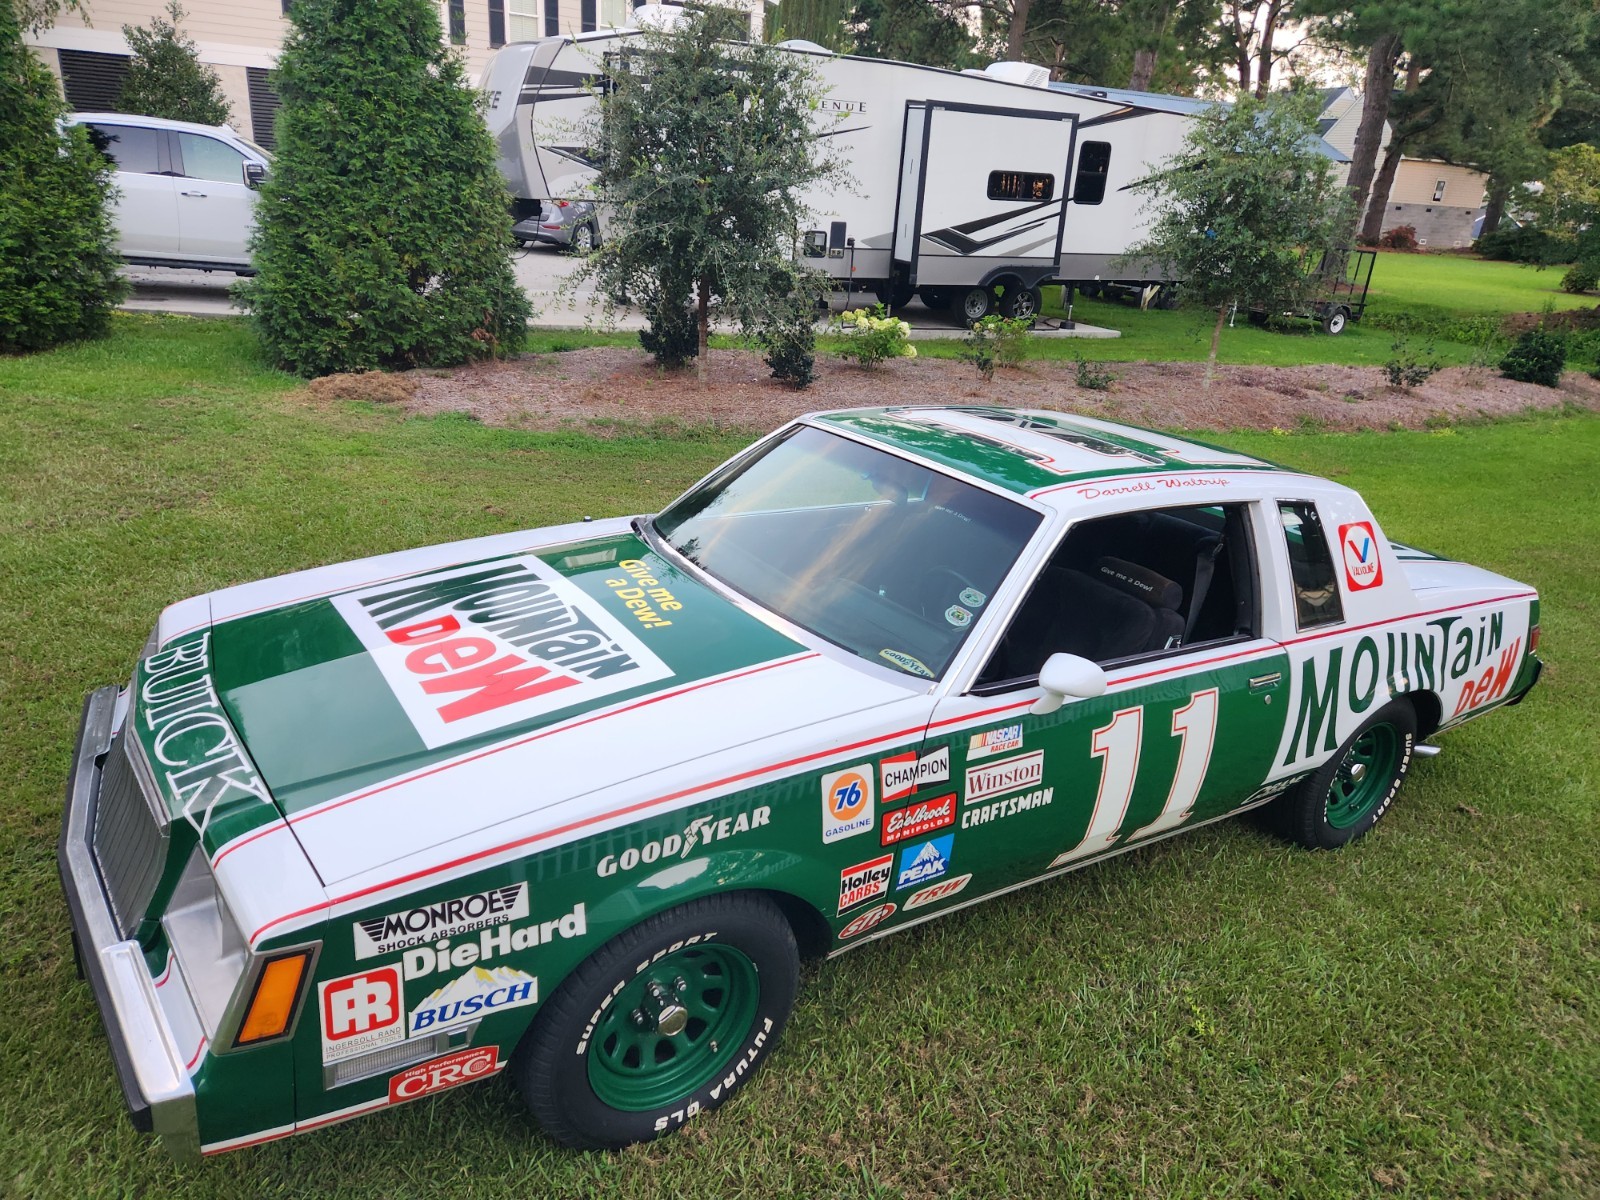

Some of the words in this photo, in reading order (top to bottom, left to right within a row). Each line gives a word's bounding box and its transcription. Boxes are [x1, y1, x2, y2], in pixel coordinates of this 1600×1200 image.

[1076, 481, 1155, 499] Darrell
[1157, 477, 1230, 487] Waltrip
[605, 578, 627, 587] a
[1115, 572, 1127, 580] me
[1352, 562, 1374, 576] VALVOLINE
[619, 559, 658, 586] Give
[647, 587, 682, 611] me
[615, 587, 672, 628] Dew!
[142, 631, 272, 841] BUICK
[986, 725, 1019, 746] NASCAR
[991, 743, 1006, 753] RACE
[1007, 740, 1019, 748] CAR
[1400, 733, 1412, 773] SUPER
[885, 758, 947, 787] CHAMPION
[968, 763, 1040, 795] Winston
[1046, 687, 1219, 869] 11
[834, 780, 862, 812] 76
[961, 787, 1054, 829] CRAFTSMAN
[1373, 778, 1401, 823] SPORT
[825, 818, 871, 837] GASOLINE
[886, 799, 950, 833] Edelbrock
[886, 817, 950, 841] MANIFOLDS
[842, 867, 890, 894] Holley
[898, 858, 946, 884] PEAK
[840, 881, 880, 908] CARBS
[911, 877, 969, 905] TRW
[383, 890, 505, 940] MONROE
[843, 906, 889, 937] STP
[378, 935, 426, 953] SHOCK
[431, 914, 510, 940] ABSORBERS
[403, 902, 587, 981] DieHard
[411, 981, 533, 1031] BUSCH
[576, 980, 625, 1055] SUPER
[636, 932, 717, 974] SPORT
[326, 1036, 374, 1052] INGERSOLL
[378, 1027, 401, 1038] RAND
[326, 1042, 379, 1059] PROFESSIONAL
[380, 1034, 402, 1044] TOOLS
[405, 1068, 426, 1078] High
[429, 1050, 485, 1070] Performance
[710, 1017, 773, 1099] FUTURA
[396, 1054, 491, 1097] CRC
[654, 1101, 700, 1131] GLS
